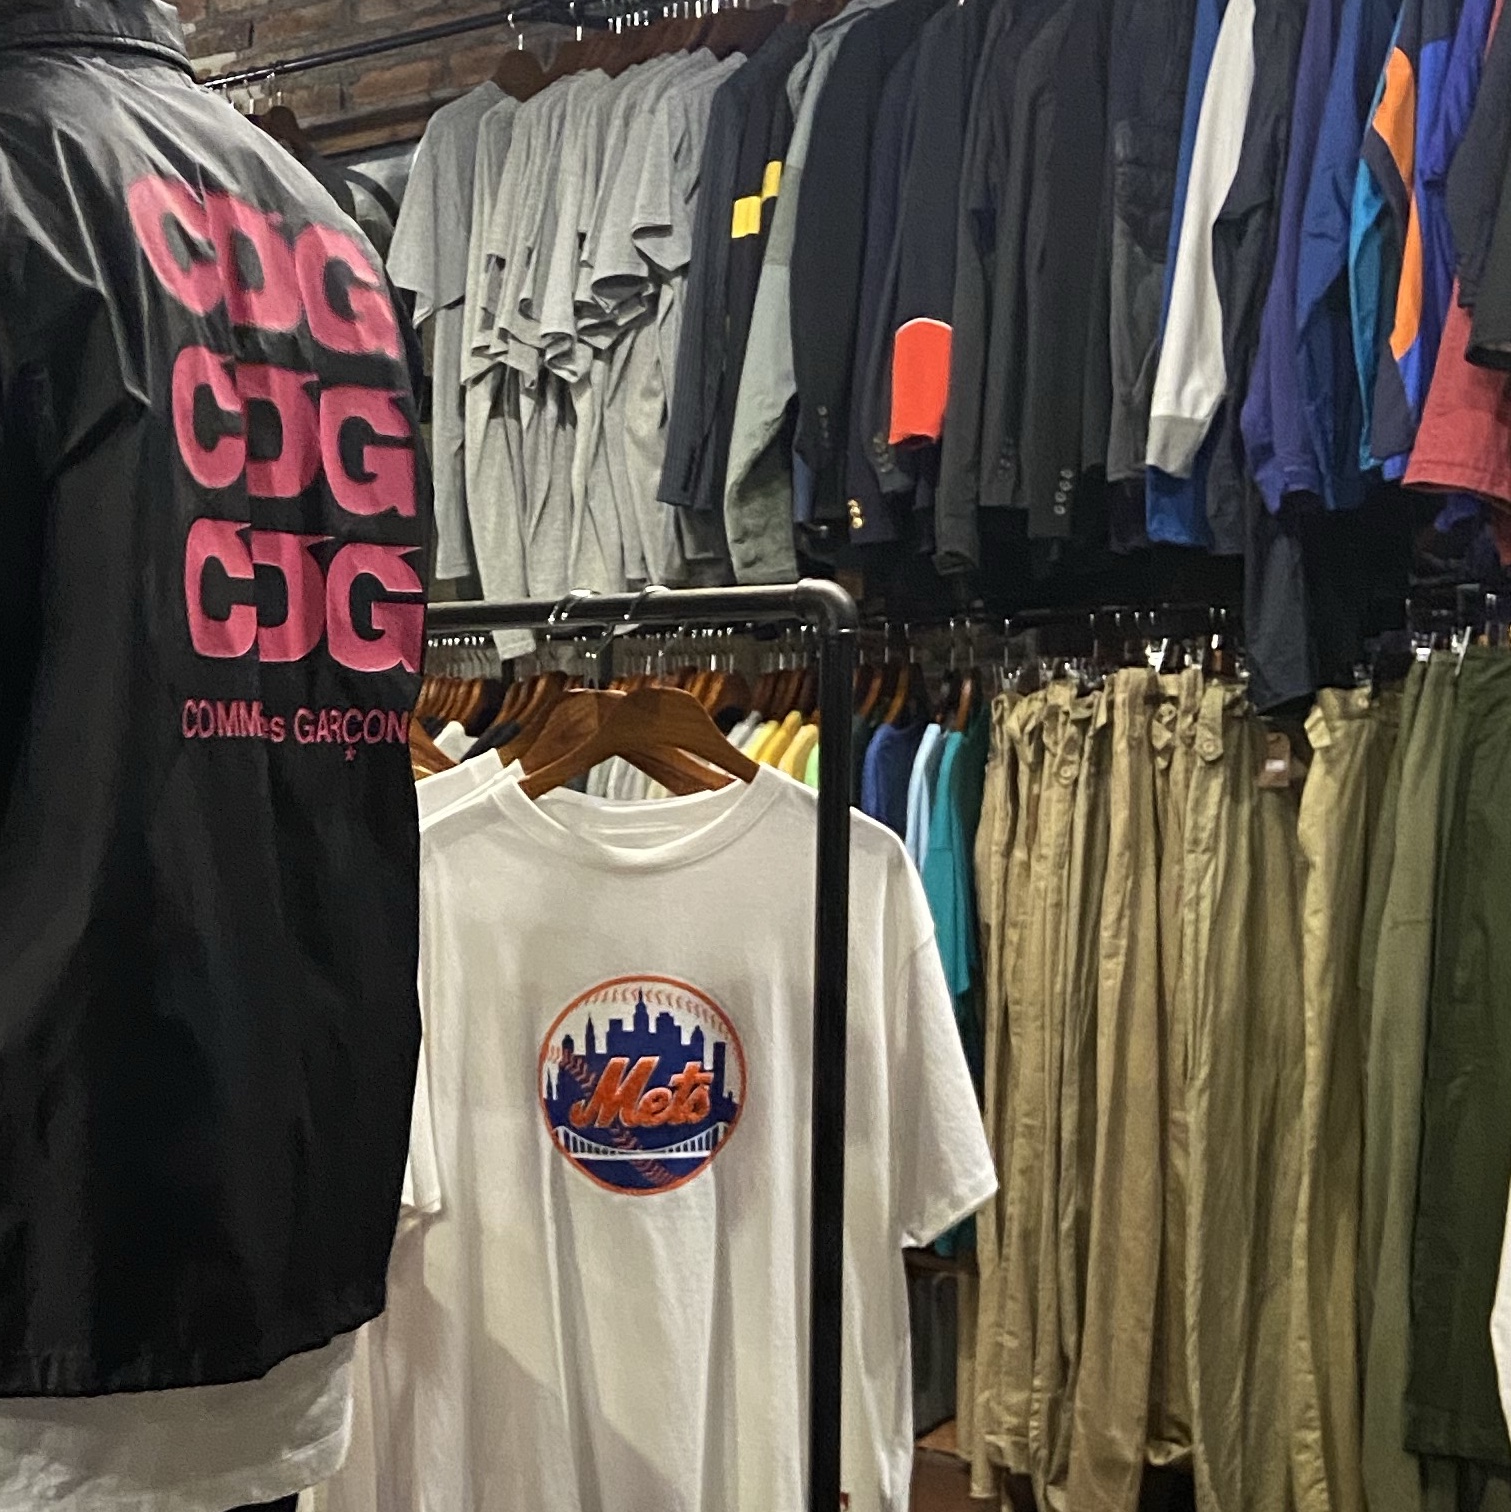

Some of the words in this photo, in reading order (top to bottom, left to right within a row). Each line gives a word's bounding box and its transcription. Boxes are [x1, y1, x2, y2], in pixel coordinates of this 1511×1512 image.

[128, 173, 401, 359] CDG
[172, 345, 417, 517] CDG
[184, 517, 424, 673] CDG
[569, 1055, 714, 1128] Mets
